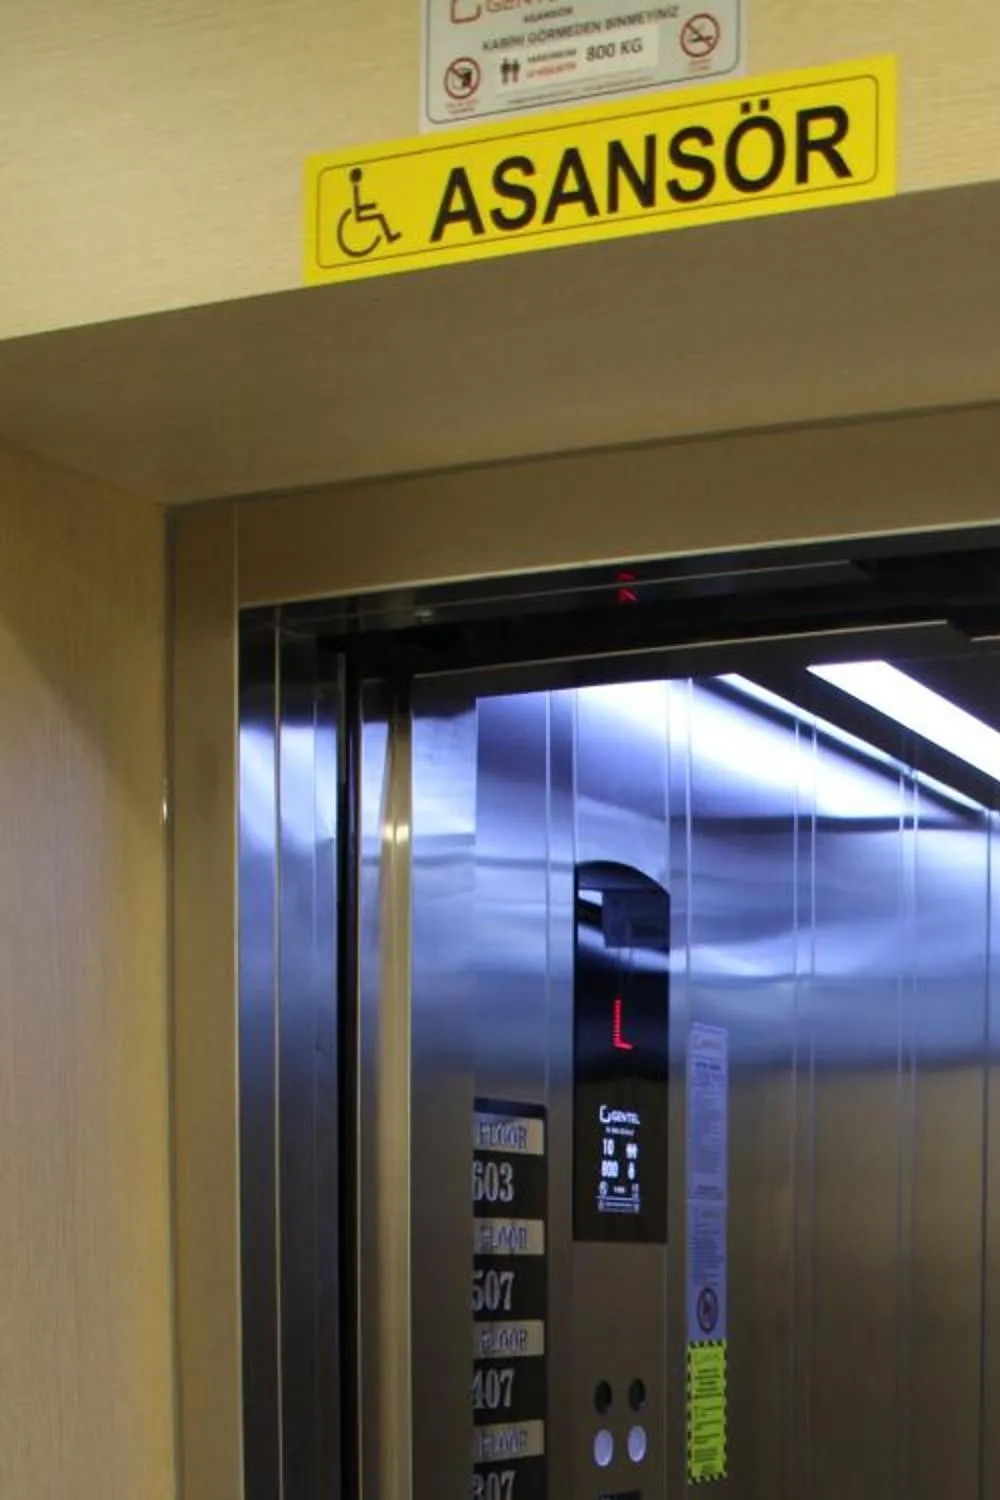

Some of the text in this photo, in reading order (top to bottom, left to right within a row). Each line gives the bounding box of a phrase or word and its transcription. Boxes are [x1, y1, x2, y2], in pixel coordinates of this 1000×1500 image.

[585, 42, 616, 61] 800
[621, 37, 643, 54] KG
[429, 99, 853, 244] ASANSÖR
[612, 996, 635, 1050] L
